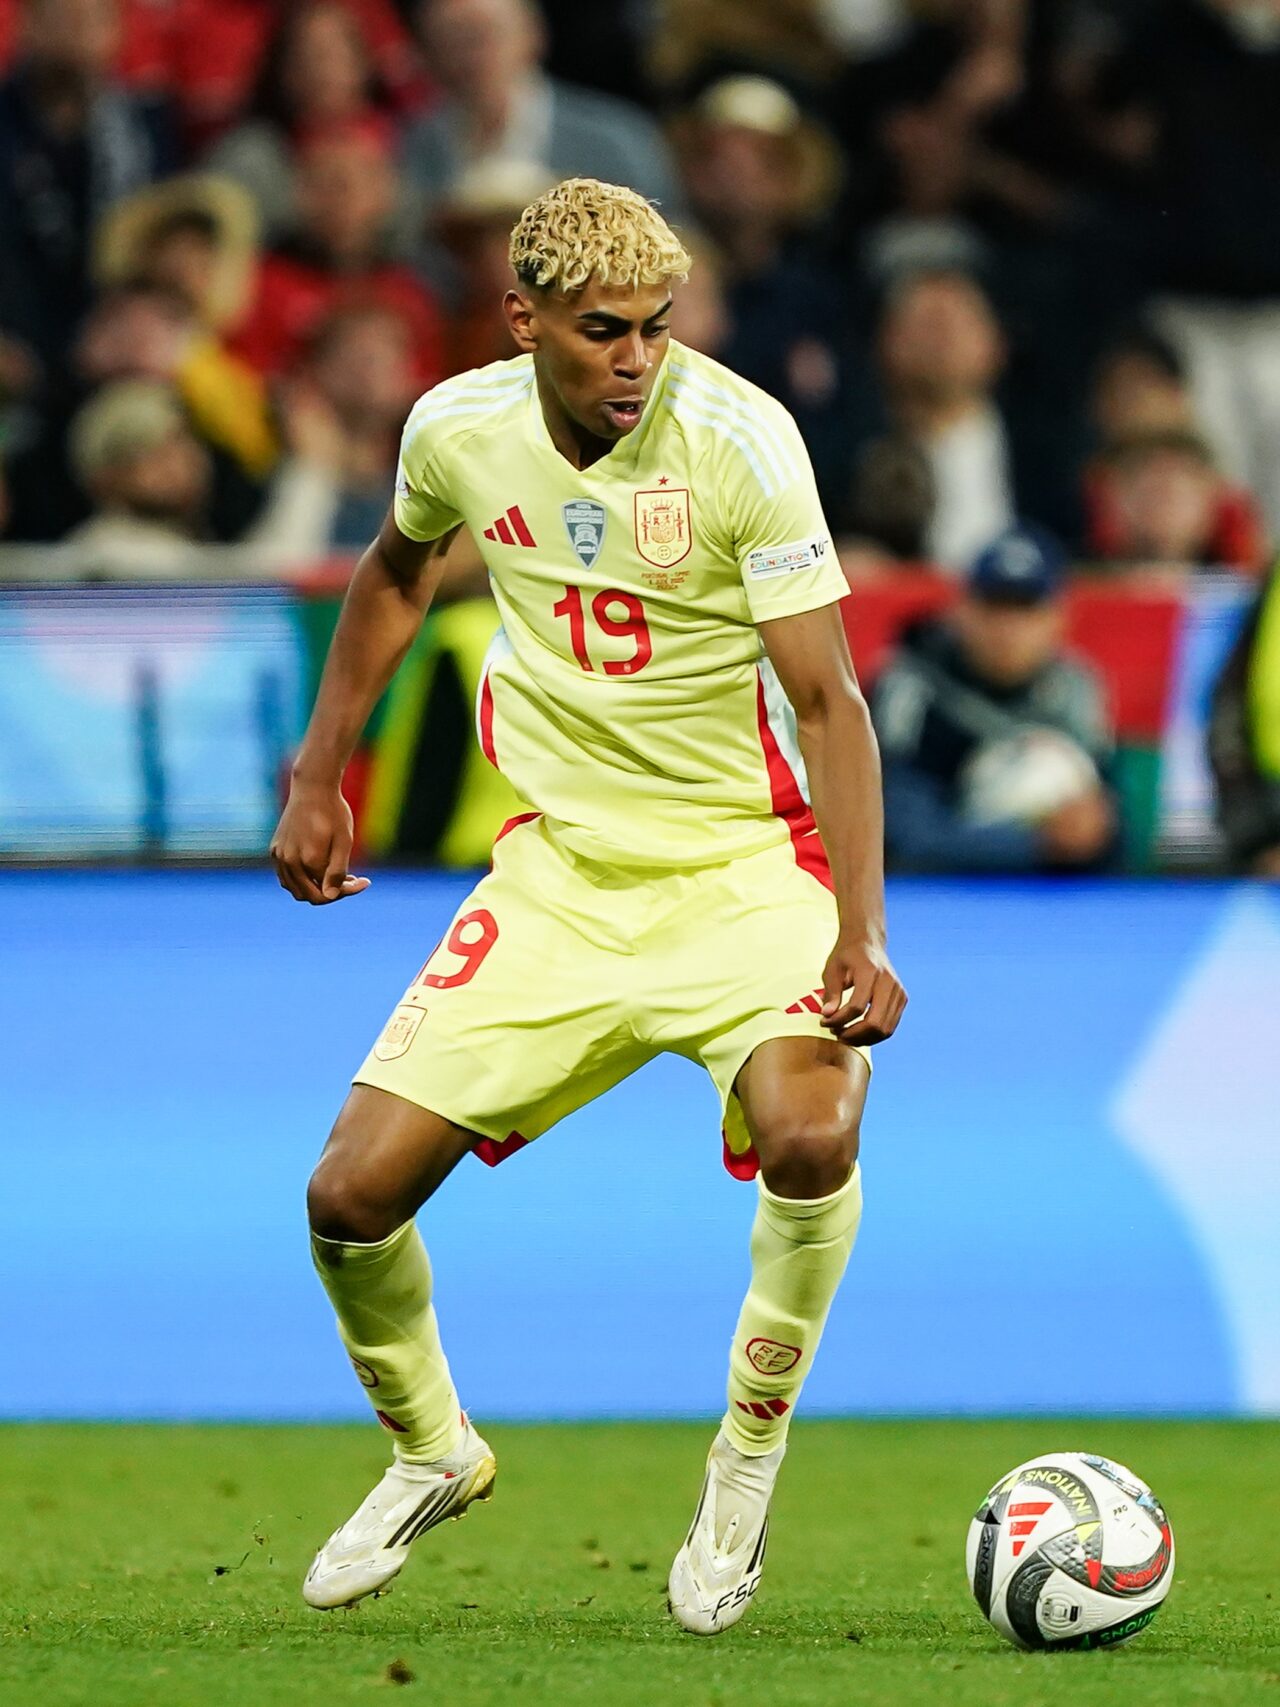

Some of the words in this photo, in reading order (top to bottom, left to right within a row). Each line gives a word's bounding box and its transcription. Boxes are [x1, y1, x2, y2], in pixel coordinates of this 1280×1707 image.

[750, 550, 810, 571] FOUNDATION
[553, 584, 653, 676] 19
[423, 909, 500, 990] 9
[1024, 1469, 1092, 1517] NATIONS
